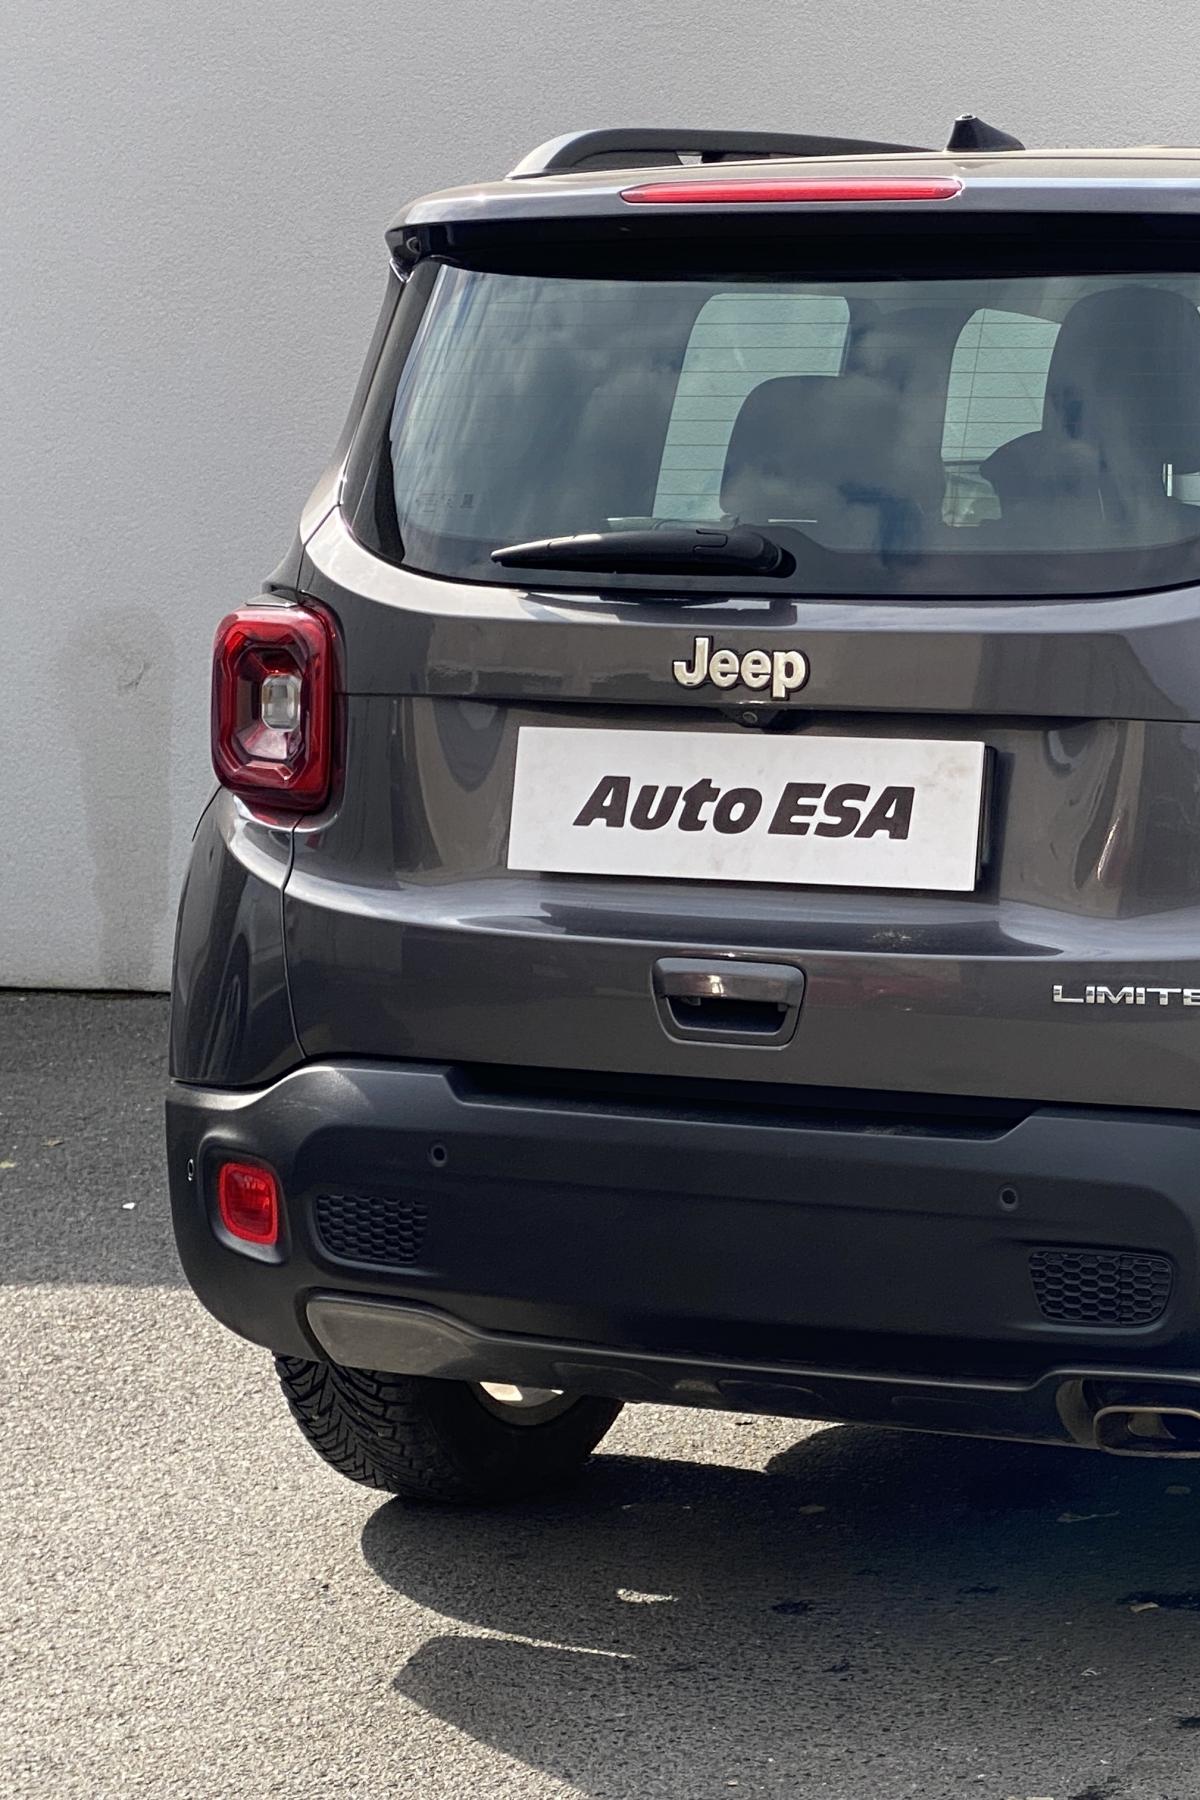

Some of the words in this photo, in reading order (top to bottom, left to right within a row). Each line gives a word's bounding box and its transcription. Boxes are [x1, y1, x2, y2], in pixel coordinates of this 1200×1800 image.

[672, 636, 809, 699] Jeep
[572, 775, 763, 834] Auto
[767, 782, 915, 840] ESA
